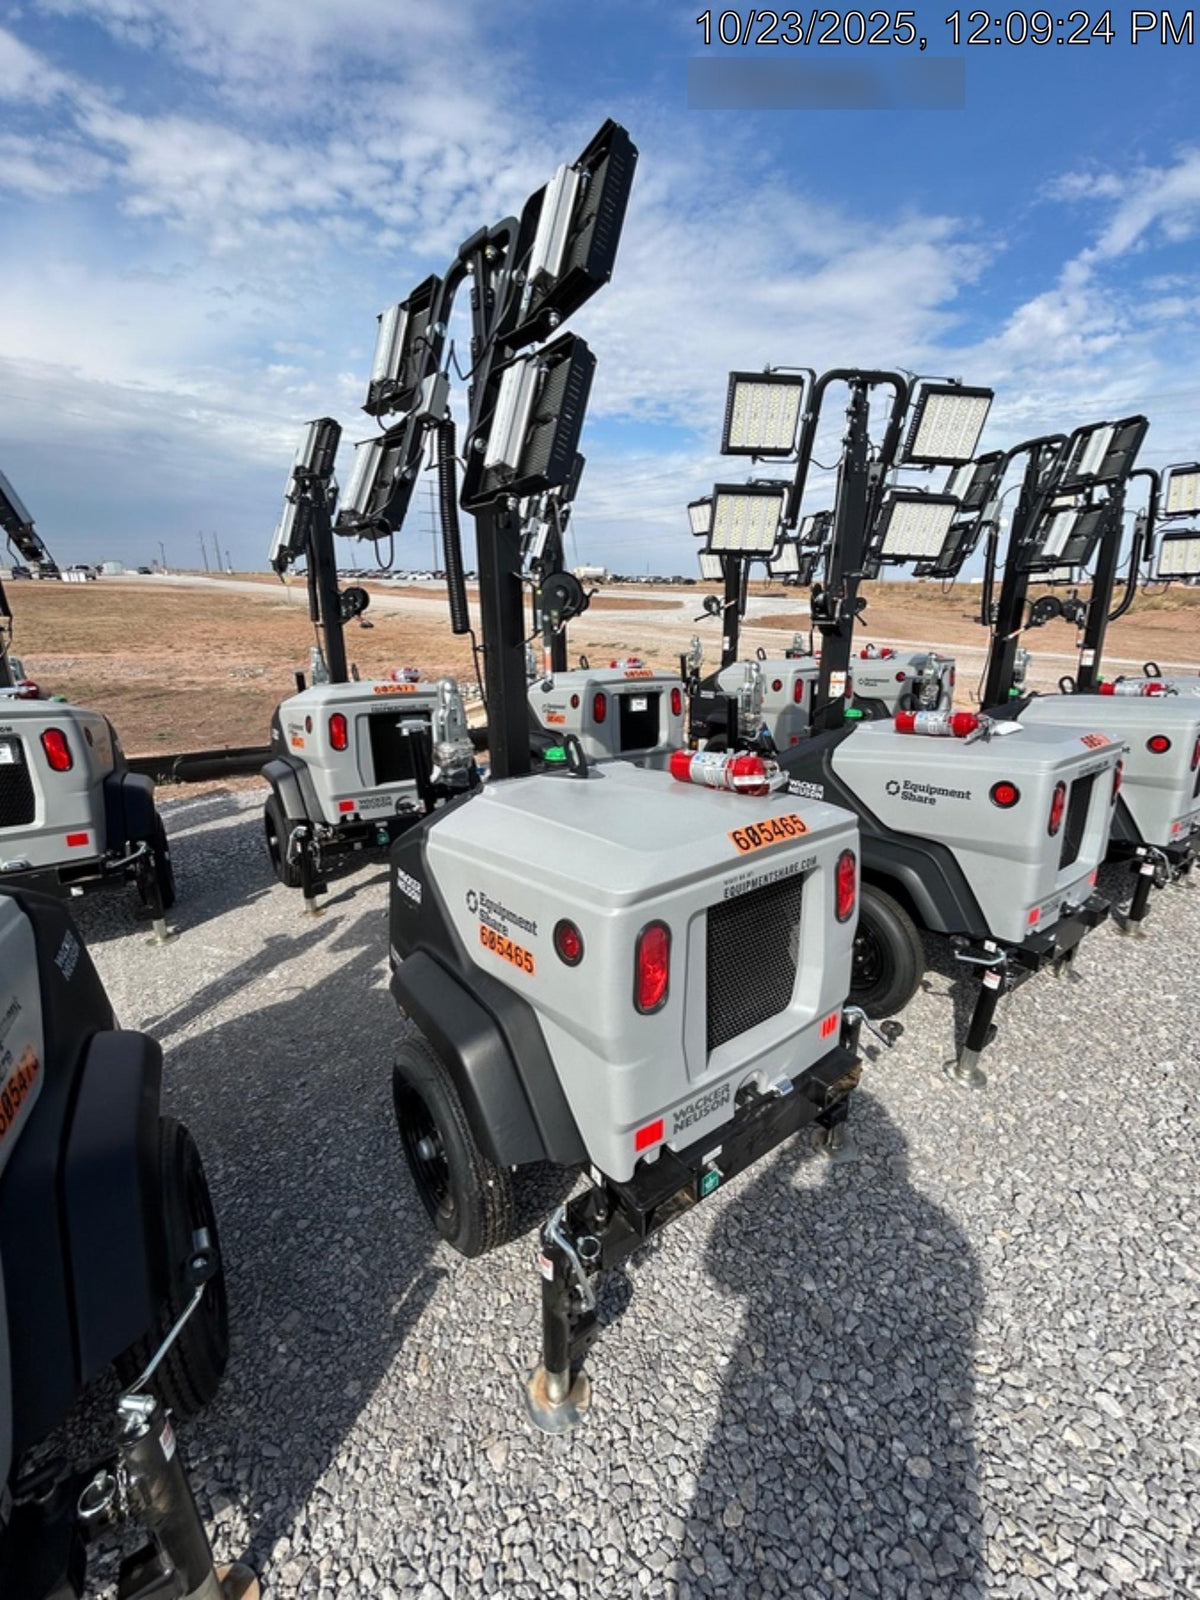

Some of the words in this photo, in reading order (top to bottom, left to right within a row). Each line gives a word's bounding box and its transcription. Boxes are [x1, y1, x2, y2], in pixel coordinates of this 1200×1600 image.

[901, 790, 936, 805] Share
[902, 780, 971, 800] Equipment
[732, 813, 807, 851] 605465
[724, 855, 817, 899] EQUIPMENTSHARE.COM
[479, 891, 538, 936] Equipment
[479, 909, 509, 937] Share
[479, 925, 535, 974] 605465
[673, 1082, 730, 1122] WACKER
[673, 1093, 730, 1135] NEUSON
